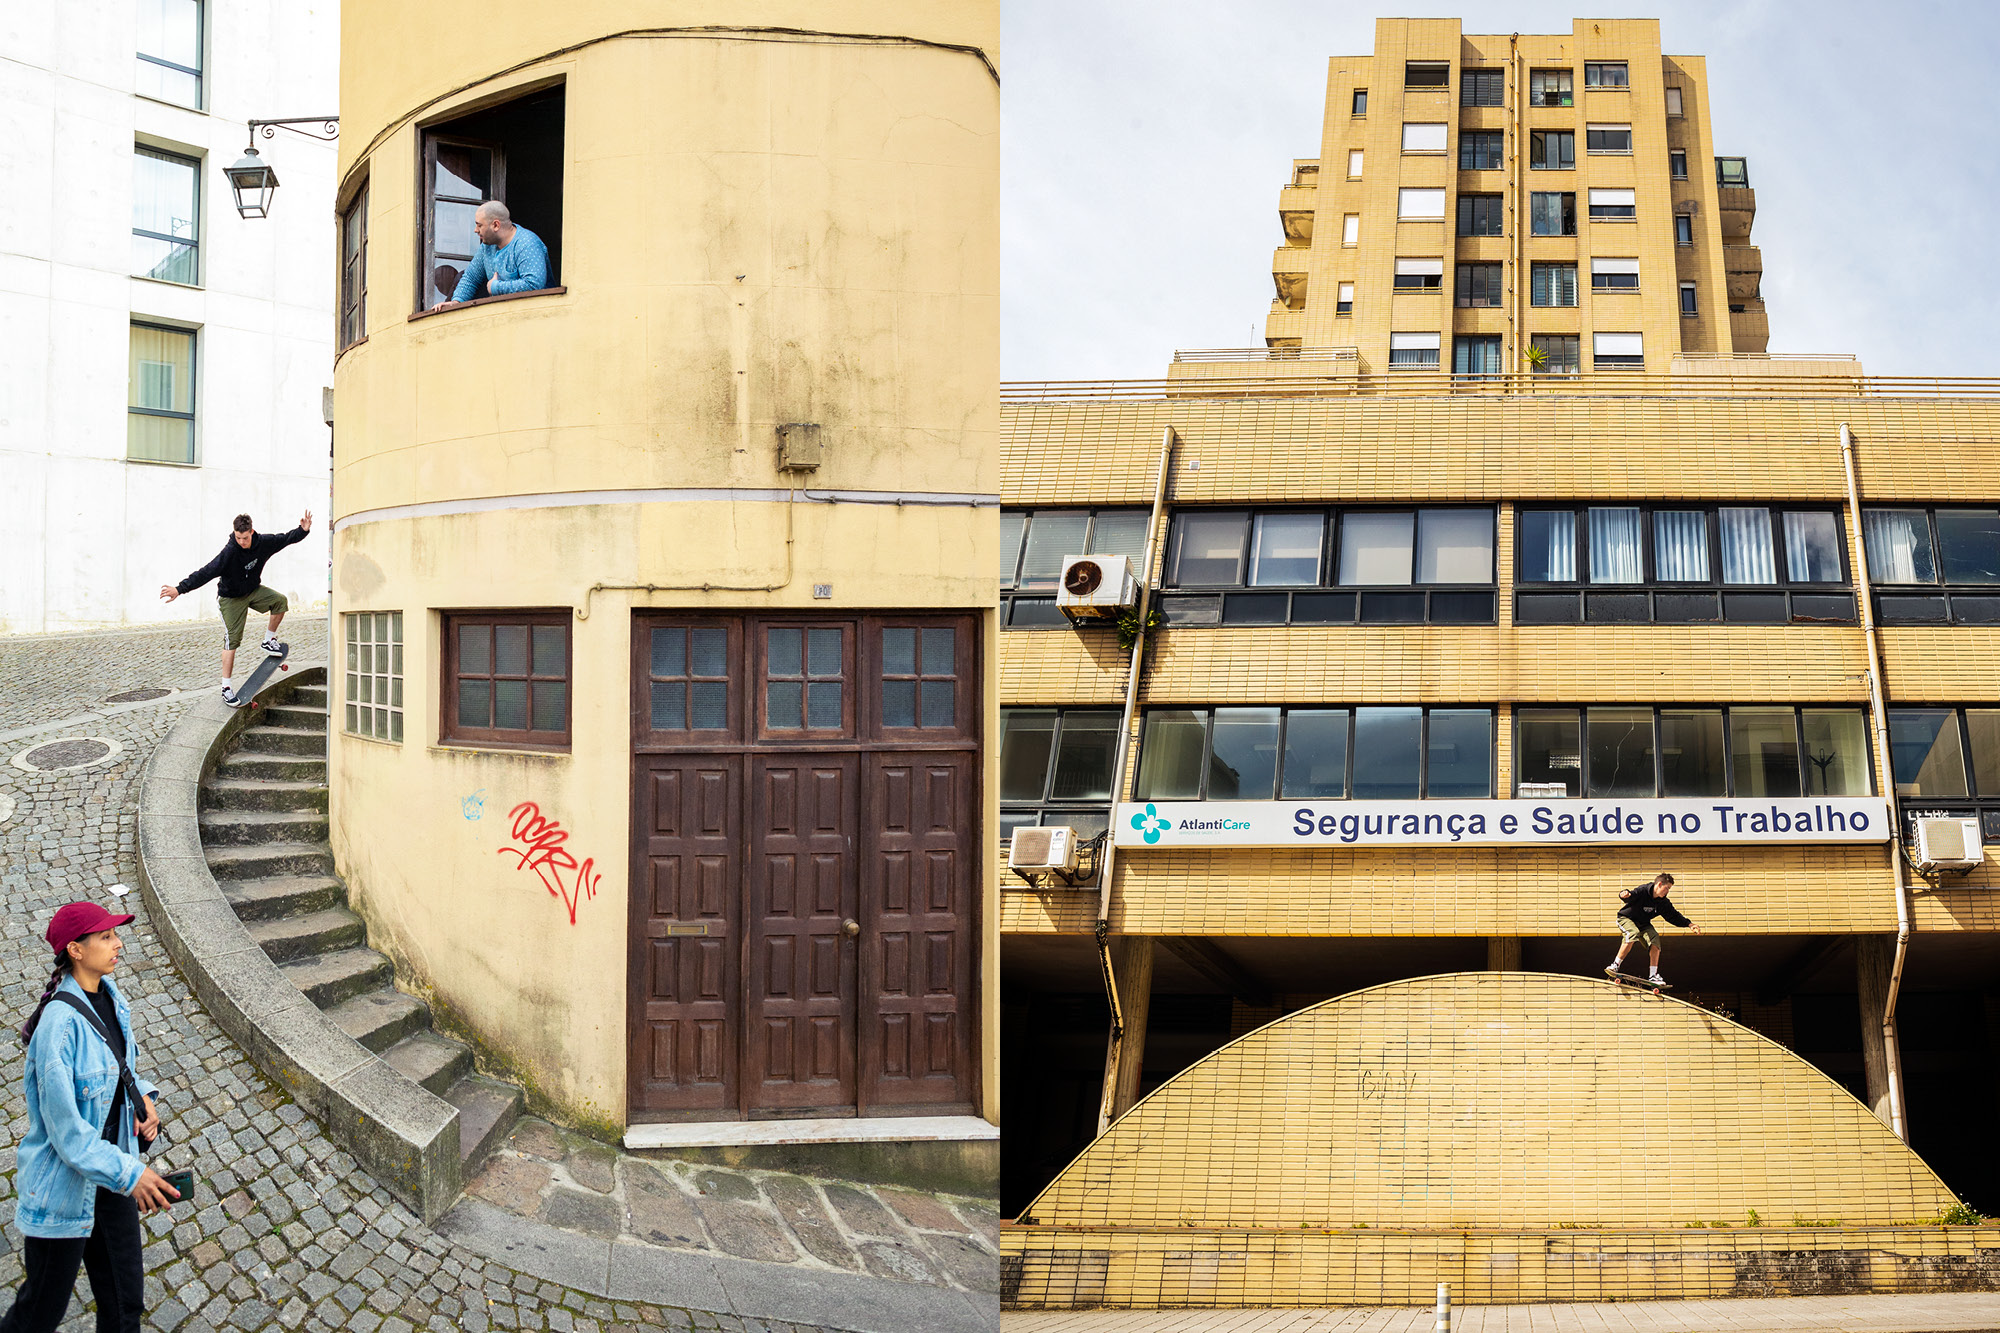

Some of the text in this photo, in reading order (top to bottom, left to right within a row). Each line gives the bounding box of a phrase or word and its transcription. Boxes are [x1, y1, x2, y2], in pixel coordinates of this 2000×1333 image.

[1178, 818, 1251, 830] AtlantiCare
[1293, 804, 1870, 842] Segurança e Saúde no Trabalho
